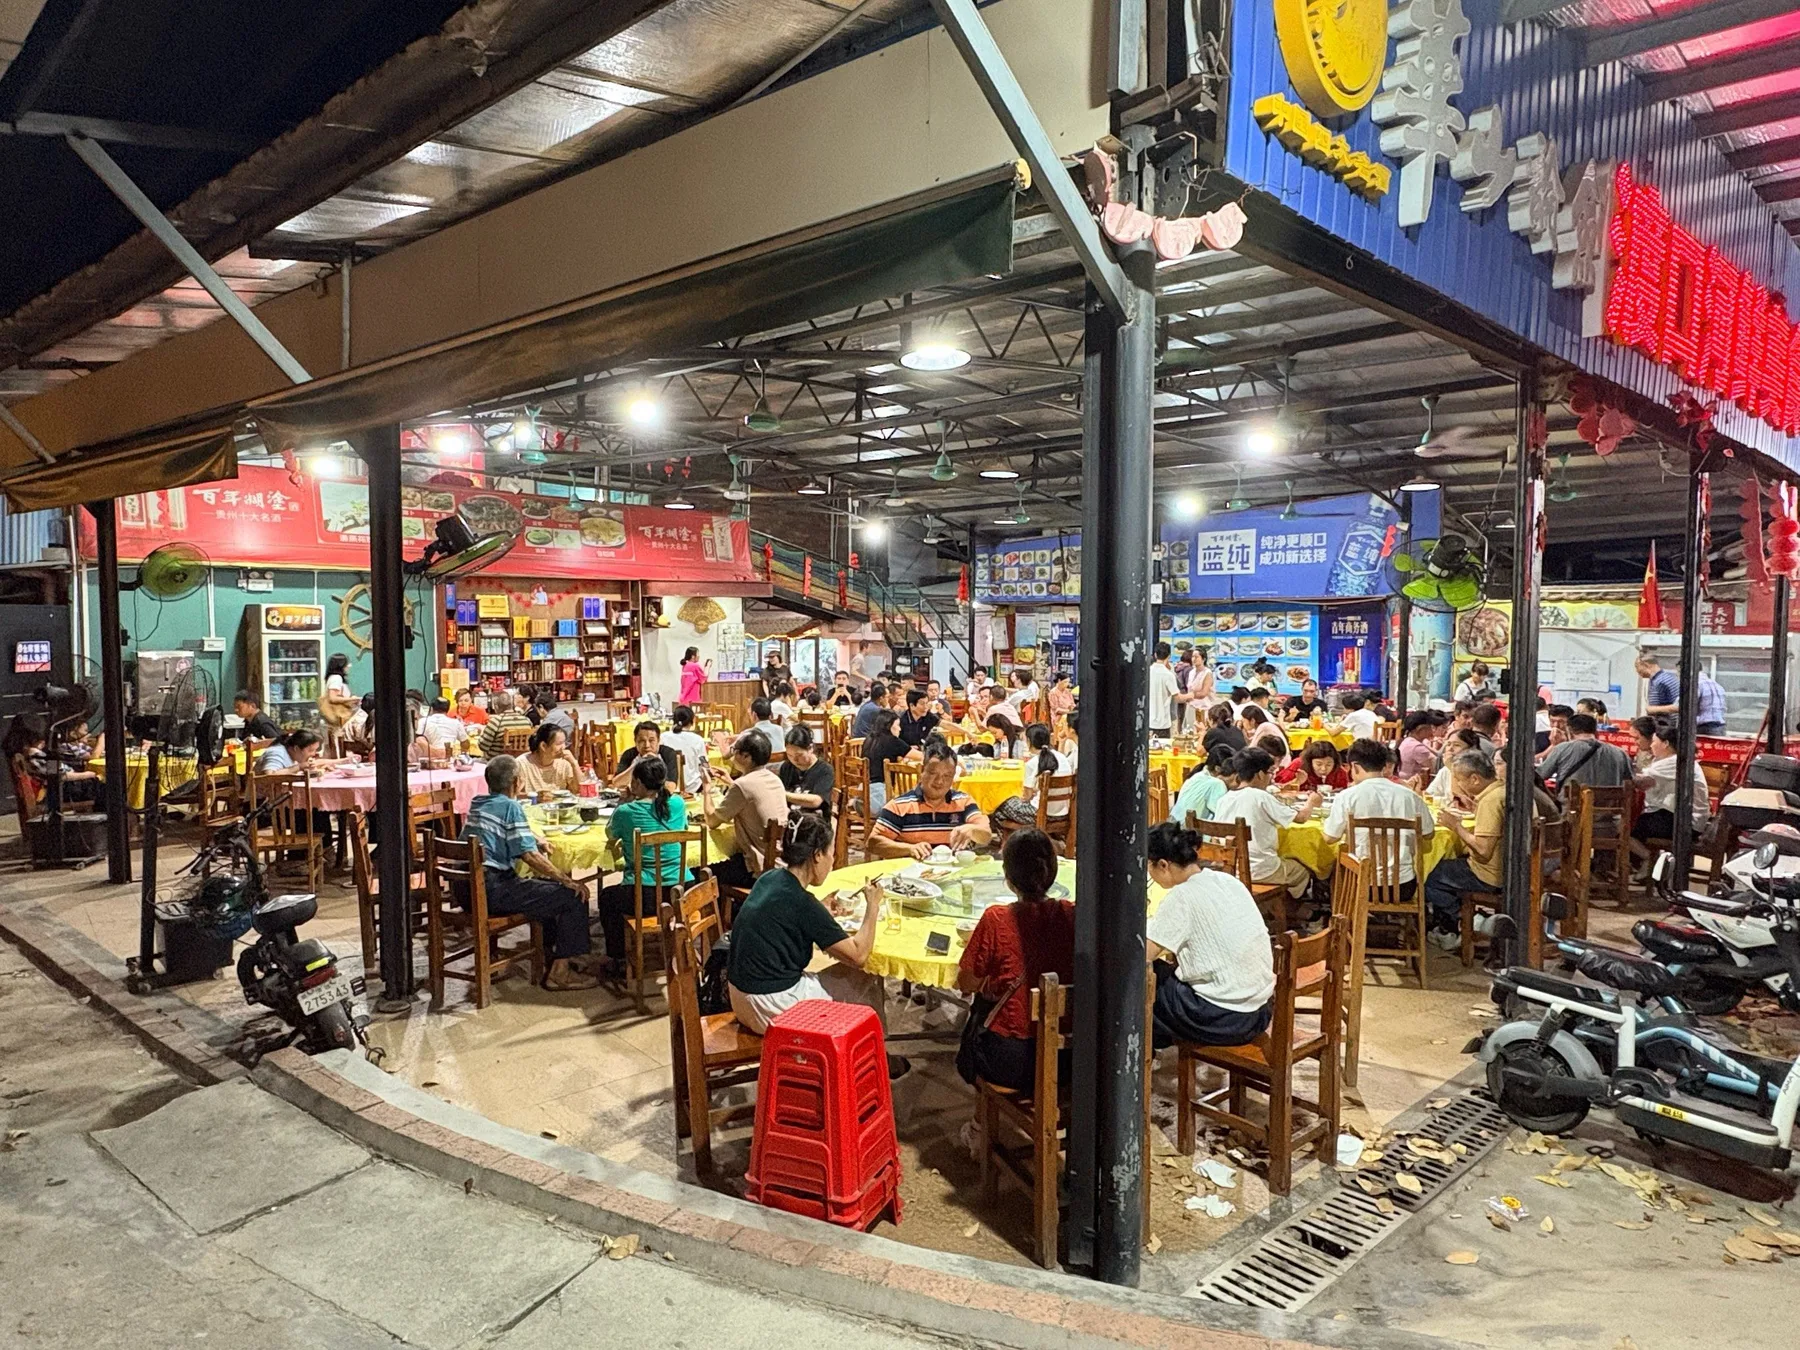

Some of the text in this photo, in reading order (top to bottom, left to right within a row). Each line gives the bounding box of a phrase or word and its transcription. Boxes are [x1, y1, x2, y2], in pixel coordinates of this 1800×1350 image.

[1260, 532, 1327, 549] 纯净更顺口
[1202, 543, 1251, 572] 蓝纯
[1259, 549, 1327, 566] 成功新选择
[304, 983, 349, 1012] 275343
